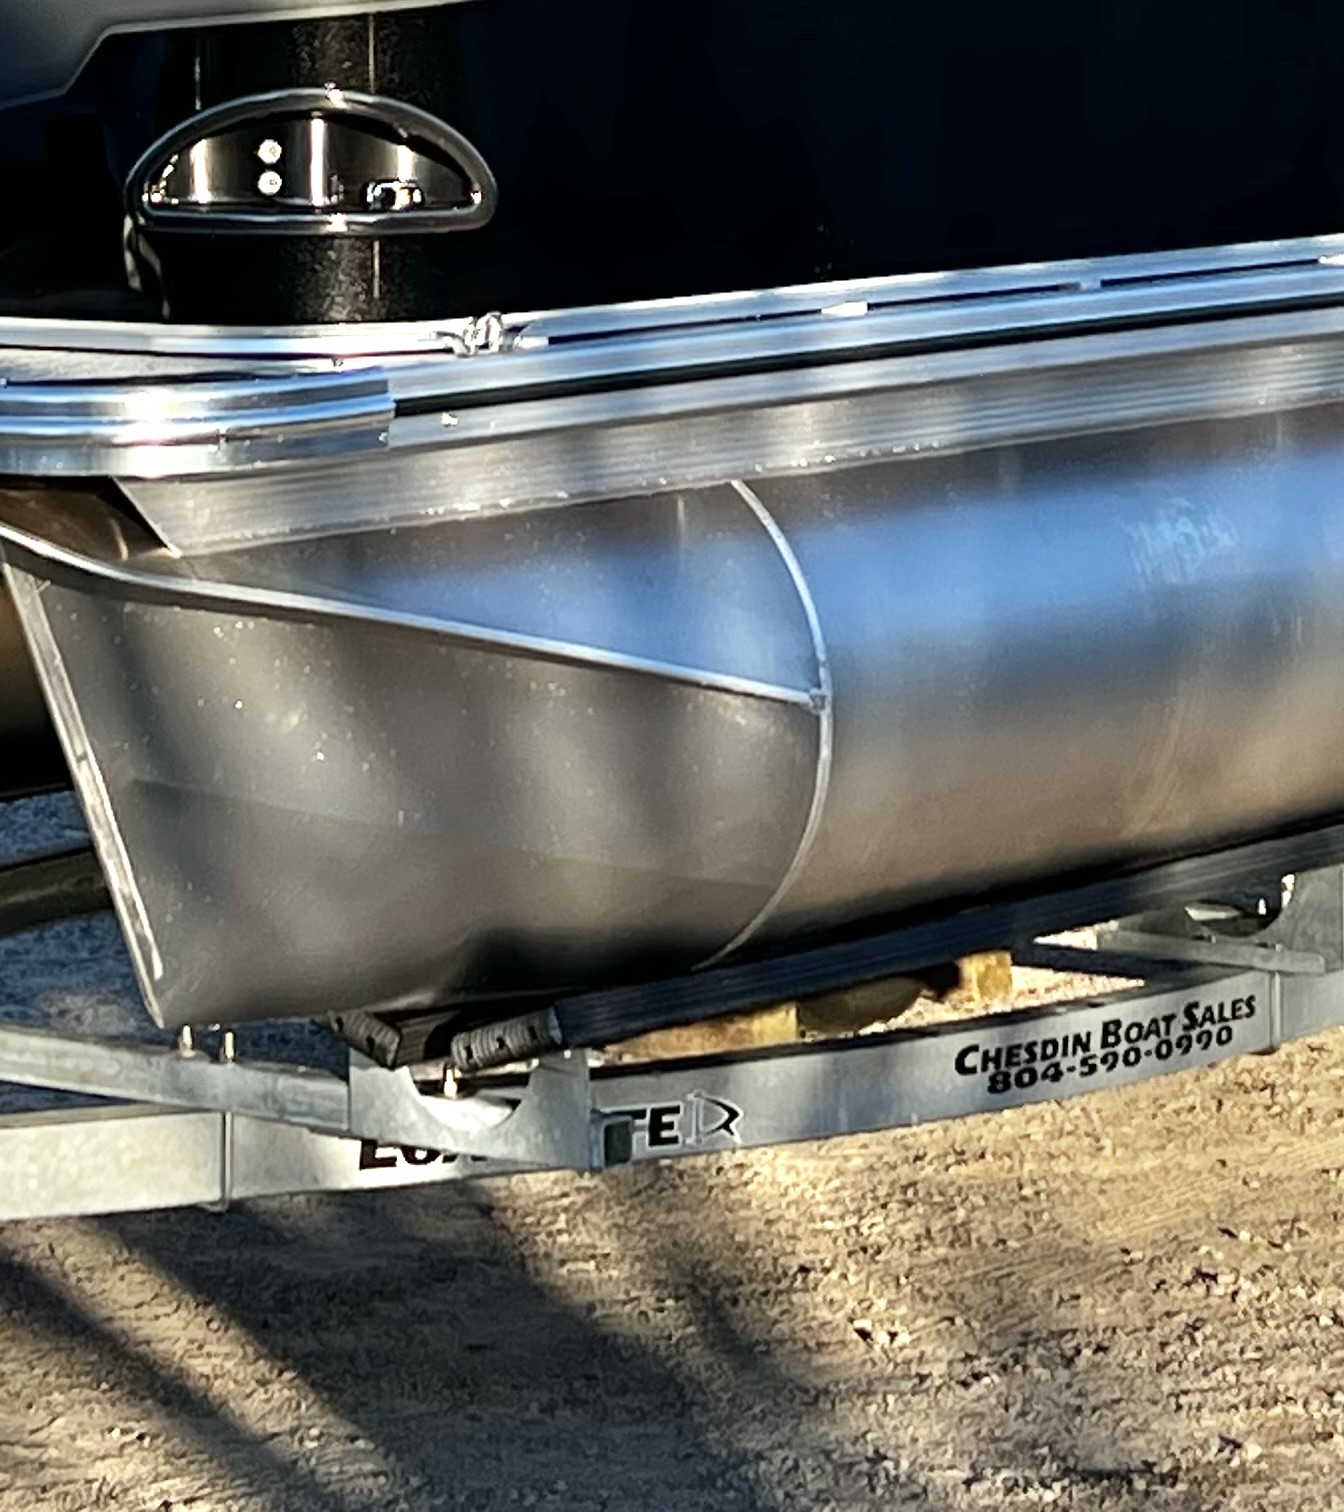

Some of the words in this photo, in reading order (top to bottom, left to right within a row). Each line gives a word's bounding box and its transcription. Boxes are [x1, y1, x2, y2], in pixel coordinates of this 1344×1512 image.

[954, 1030, 1092, 1076] CHESDIN
[1100, 1012, 1177, 1050] BOAT
[1182, 994, 1257, 1032] SALES
[986, 1024, 1234, 1095] 804-590-0990
